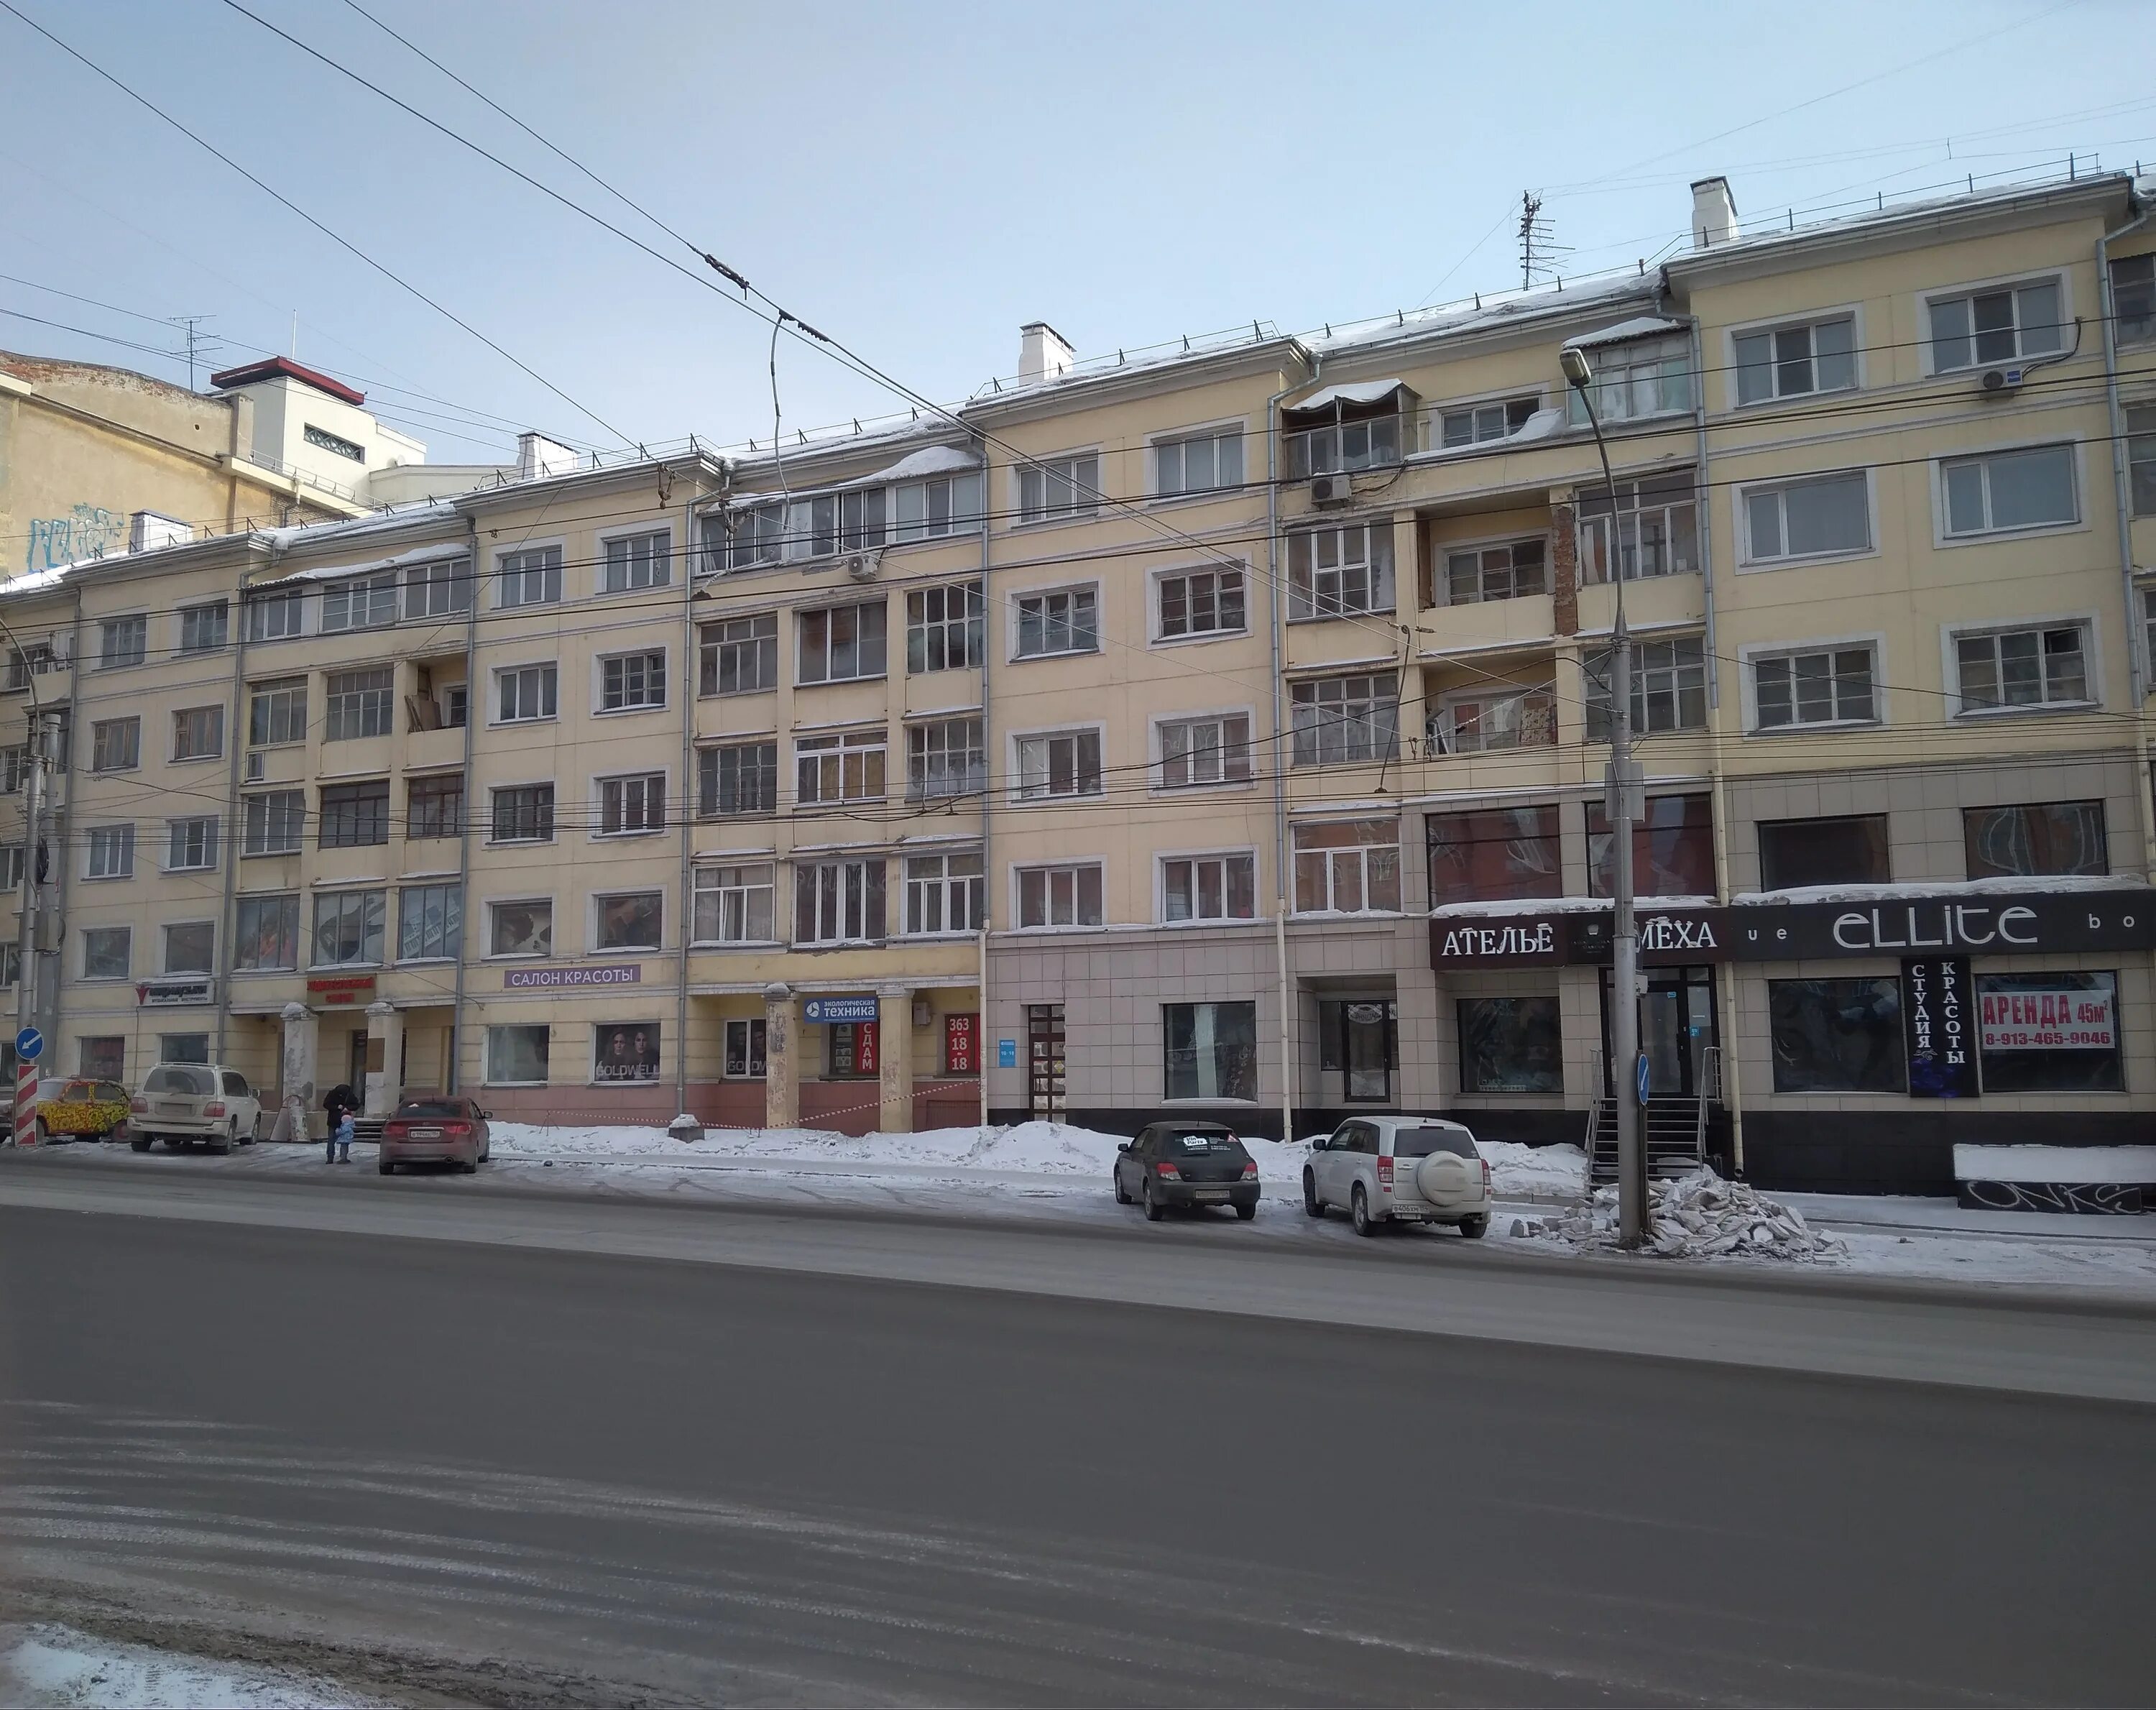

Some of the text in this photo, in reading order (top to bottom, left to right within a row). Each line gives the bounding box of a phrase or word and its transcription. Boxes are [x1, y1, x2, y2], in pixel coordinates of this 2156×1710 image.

[1441, 925, 1554, 956] АТЕЛЬЕ
[511, 968, 633, 986] САЛОН КРАСОТЫ
[824, 1006, 875, 1016] техника
[1912, 962, 1966, 1064] СТУДИЯ КРАСОТЫ
[1984, 995, 2072, 1029] АРЕНДА
[949, 1018, 969, 1031] 363
[952, 1037, 967, 1050] 18
[1986, 1031, 2111, 1046] 8-913-465-9046
[862, 1024, 872, 1069] СДАМ
[595, 1063, 660, 1077] GOLDWELL
[952, 1057, 967, 1070] 18
